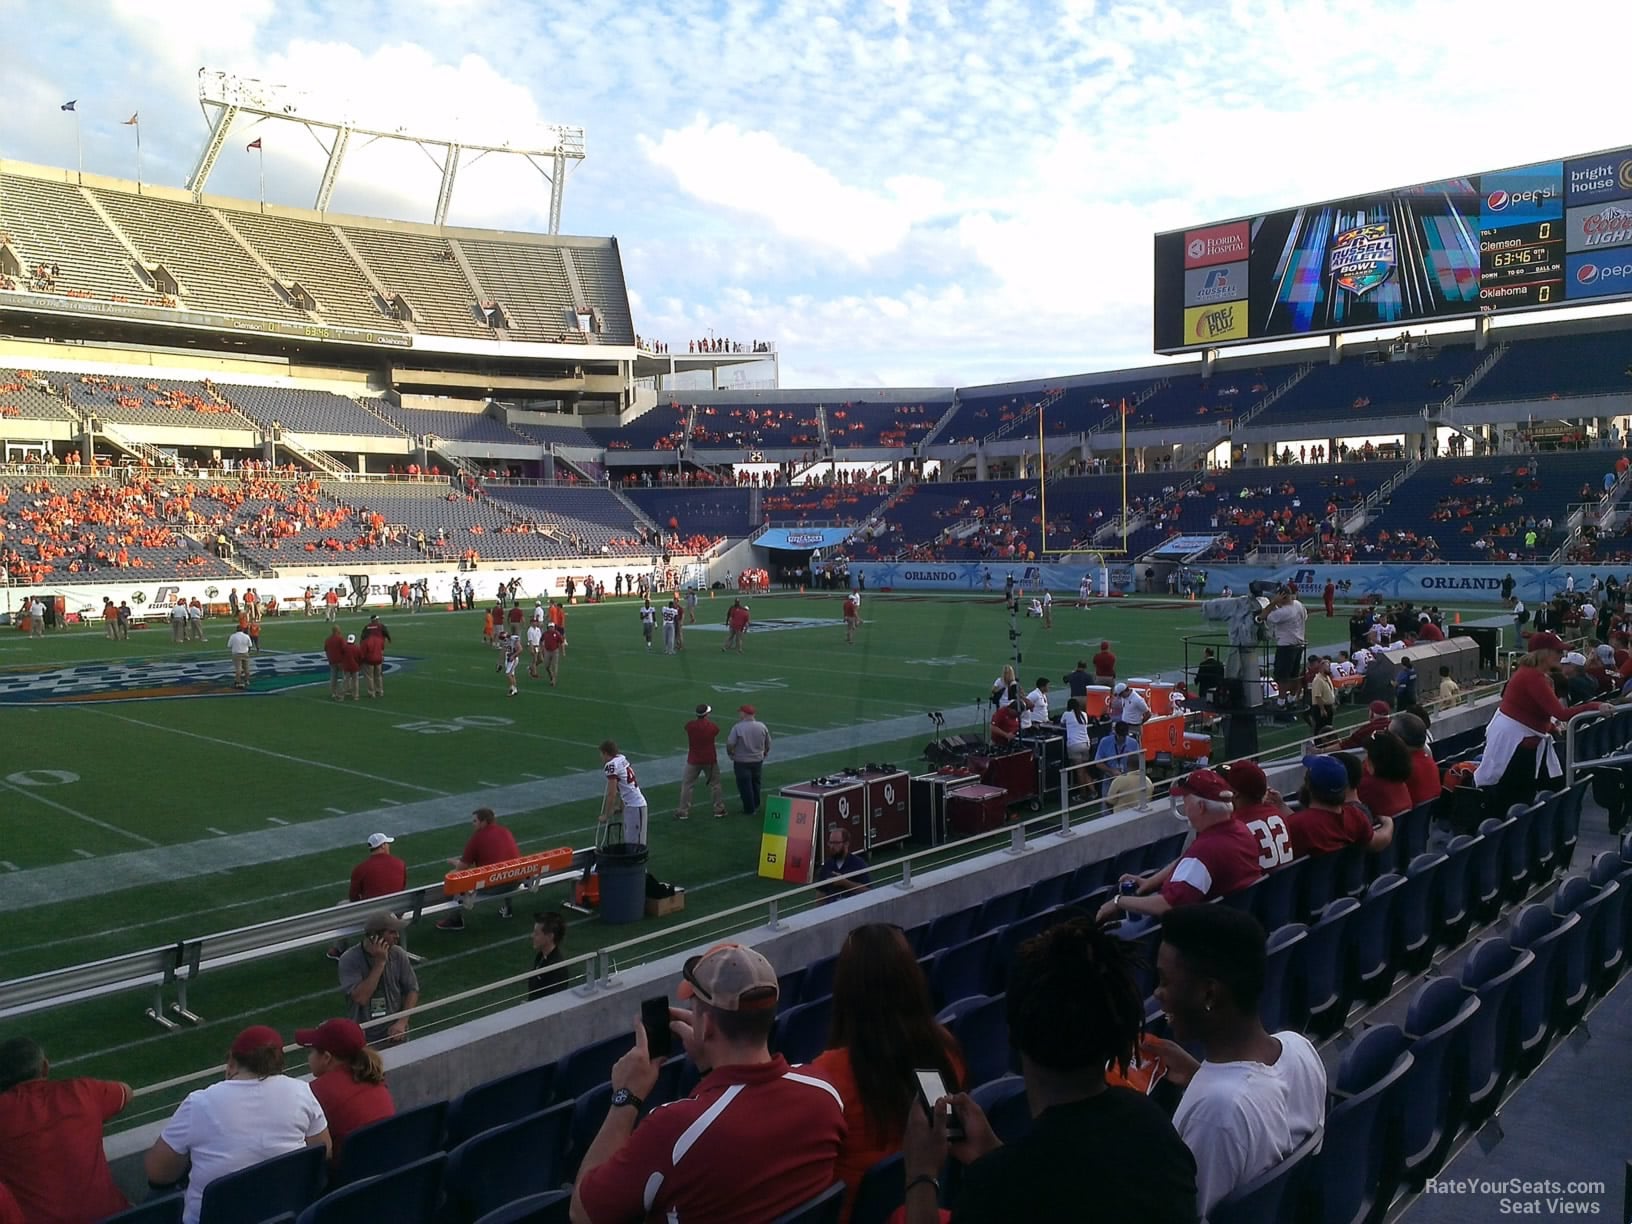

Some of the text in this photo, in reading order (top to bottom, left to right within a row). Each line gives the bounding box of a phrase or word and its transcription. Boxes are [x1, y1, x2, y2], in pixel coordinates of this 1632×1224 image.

[1571, 165, 1613, 181] bright
[1571, 179, 1614, 193] house
[1539, 223, 1550, 239] 0
[1207, 235, 1242, 248] FLORIDA
[1207, 242, 1246, 256] HOSPITAL
[1480, 239, 1521, 251] Clemson
[1332, 241, 1392, 260] RUSSELL
[1495, 250, 1531, 266] 63:46
[1341, 261, 1378, 273] BOWL
[1480, 286, 1528, 299] Oklahoma
[1539, 286, 1550, 302] 0
[1206, 306, 1233, 325] TIRES
[233, 321, 263, 330] Clemson
[305, 326, 329, 338] 63:46
[1209, 317, 1234, 335] PLUS
[905, 571, 957, 581] ORLANDO
[1246, 815, 1294, 869] 32
[489, 864, 539, 882] GATORADE
